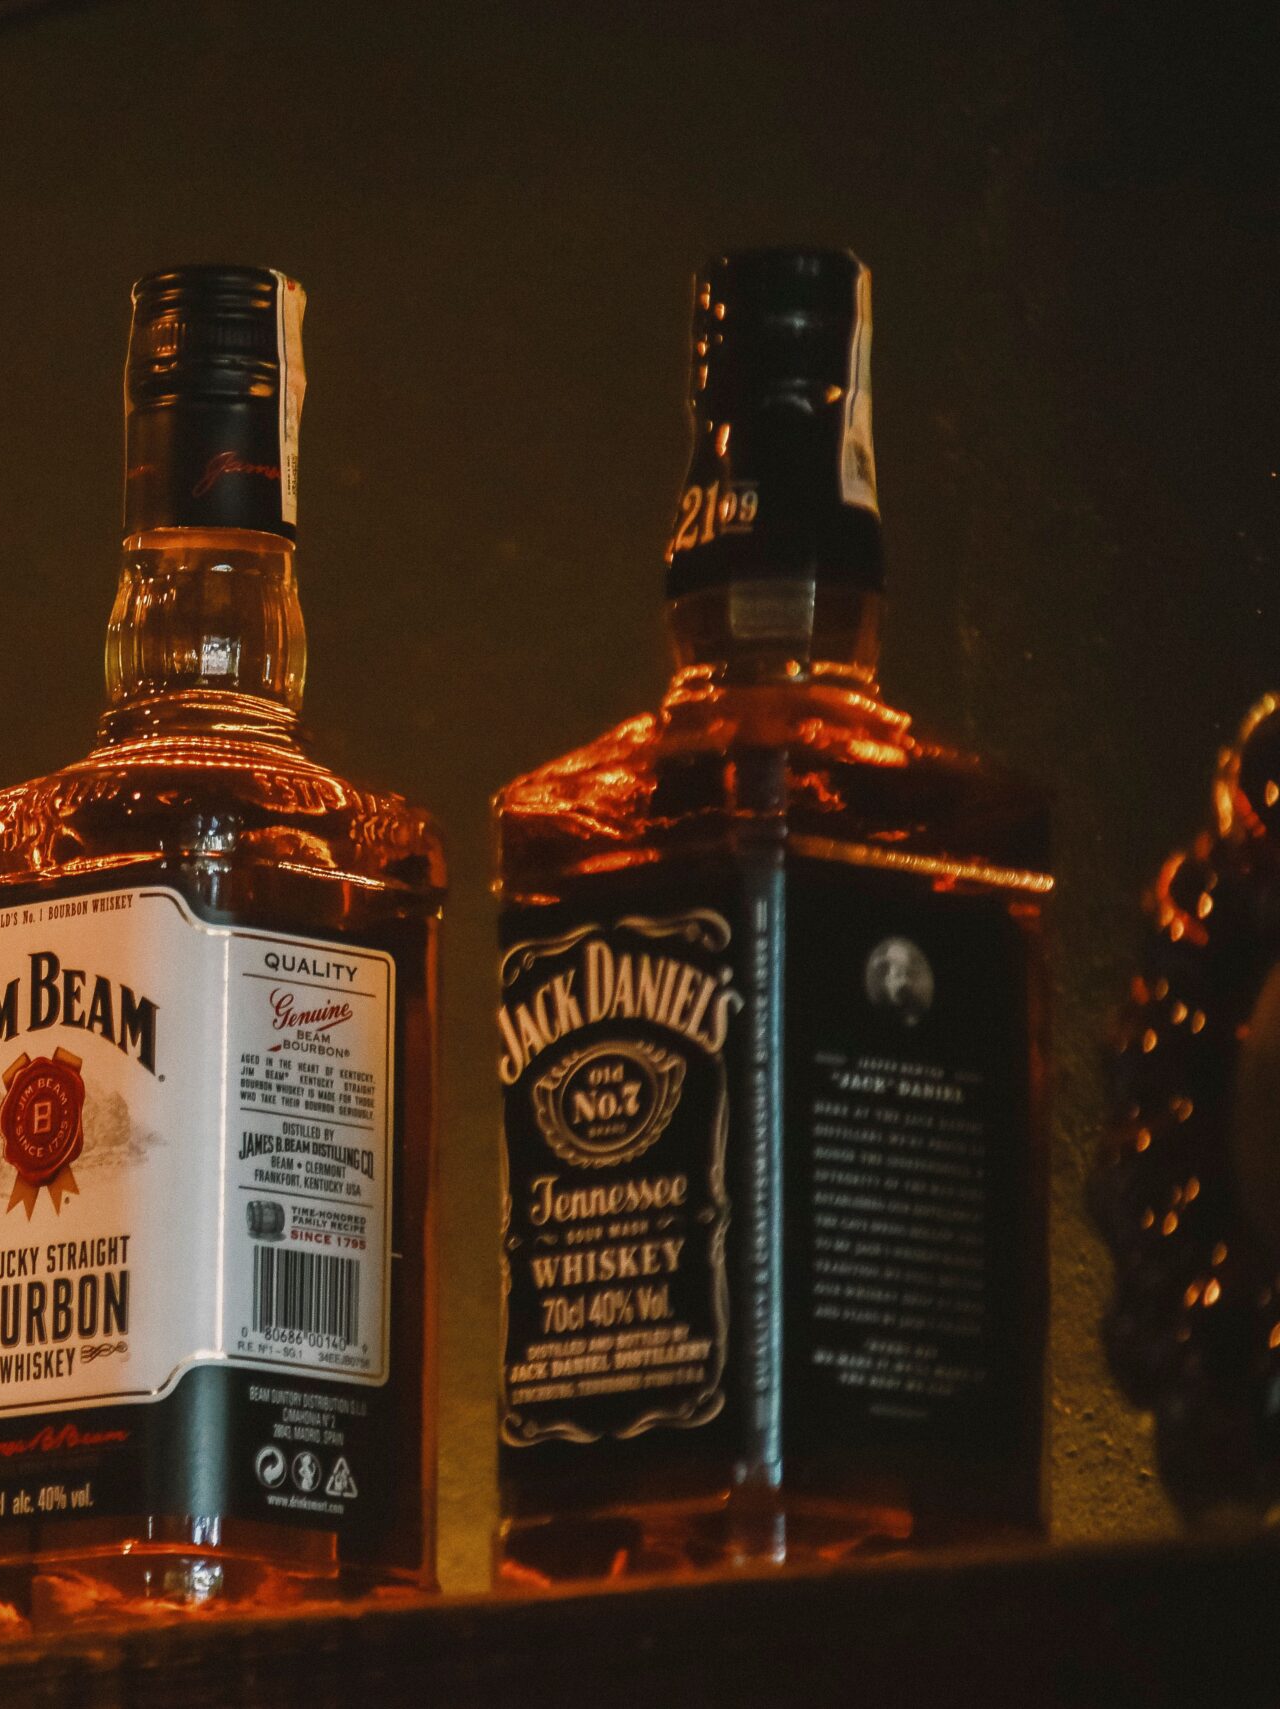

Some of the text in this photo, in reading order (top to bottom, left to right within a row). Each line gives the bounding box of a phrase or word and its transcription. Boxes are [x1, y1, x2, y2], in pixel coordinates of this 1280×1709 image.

[22, 910, 36, 925] No.
[48, 901, 88, 920] BOURBON
[92, 894, 134, 913] WHISKEY
[265, 952, 358, 982] QUALITY
[27, 951, 160, 1077] BEAM
[269, 987, 353, 1032] Genuine
[496, 939, 745, 1085] JACK DANIEL'S
[283, 1039, 344, 1058] BOURBON
[297, 1029, 331, 1044] BEAM
[240, 1053, 260, 1065] AGED
[265, 1057, 273, 1067] IN
[279, 1059, 292, 1071] THE
[298, 1062, 320, 1074] HEART
[325, 1066, 334, 1077] OF
[240, 1066, 255, 1077] JIM
[300, 1075, 334, 1089] KENTUCKY
[18, 1077, 68, 1111] JIM BEAM
[240, 1078, 272, 1092] BOURBON
[276, 1083, 305, 1098] WHISKEY
[240, 1091, 256, 1102] WHO
[261, 1093, 277, 1105] TAKE
[281, 1096, 300, 1108] THEIR
[16, 1120, 68, 1157] SINCE 1795
[282, 1121, 335, 1142] DISTILLED BY
[238, 1131, 274, 1160] JAMES
[312, 1140, 360, 1170] DISTILLING
[271, 1155, 346, 1179] BEAM CLERMONT
[304, 1176, 344, 1194] KENTUCKY
[346, 1183, 362, 1197] USA
[530, 1174, 688, 1226] Tennessee
[292, 1215, 366, 1234] FAMILY RECIPE
[46, 1235, 131, 1274] STRAIGHT
[291, 1229, 367, 1251] SINCE 1795
[531, 1238, 685, 1290] WHISKEY
[588, 1288, 635, 1329] 40%
[241, 1326, 249, 1338] 0
[264, 1327, 303, 1346] 80686
[308, 1332, 347, 1351] 00140
[0, 1347, 76, 1385] WHISKEY
[12, 1489, 34, 1515] alc.
[37, 1484, 68, 1512] 40%
[70, 1482, 95, 1509] vol.
